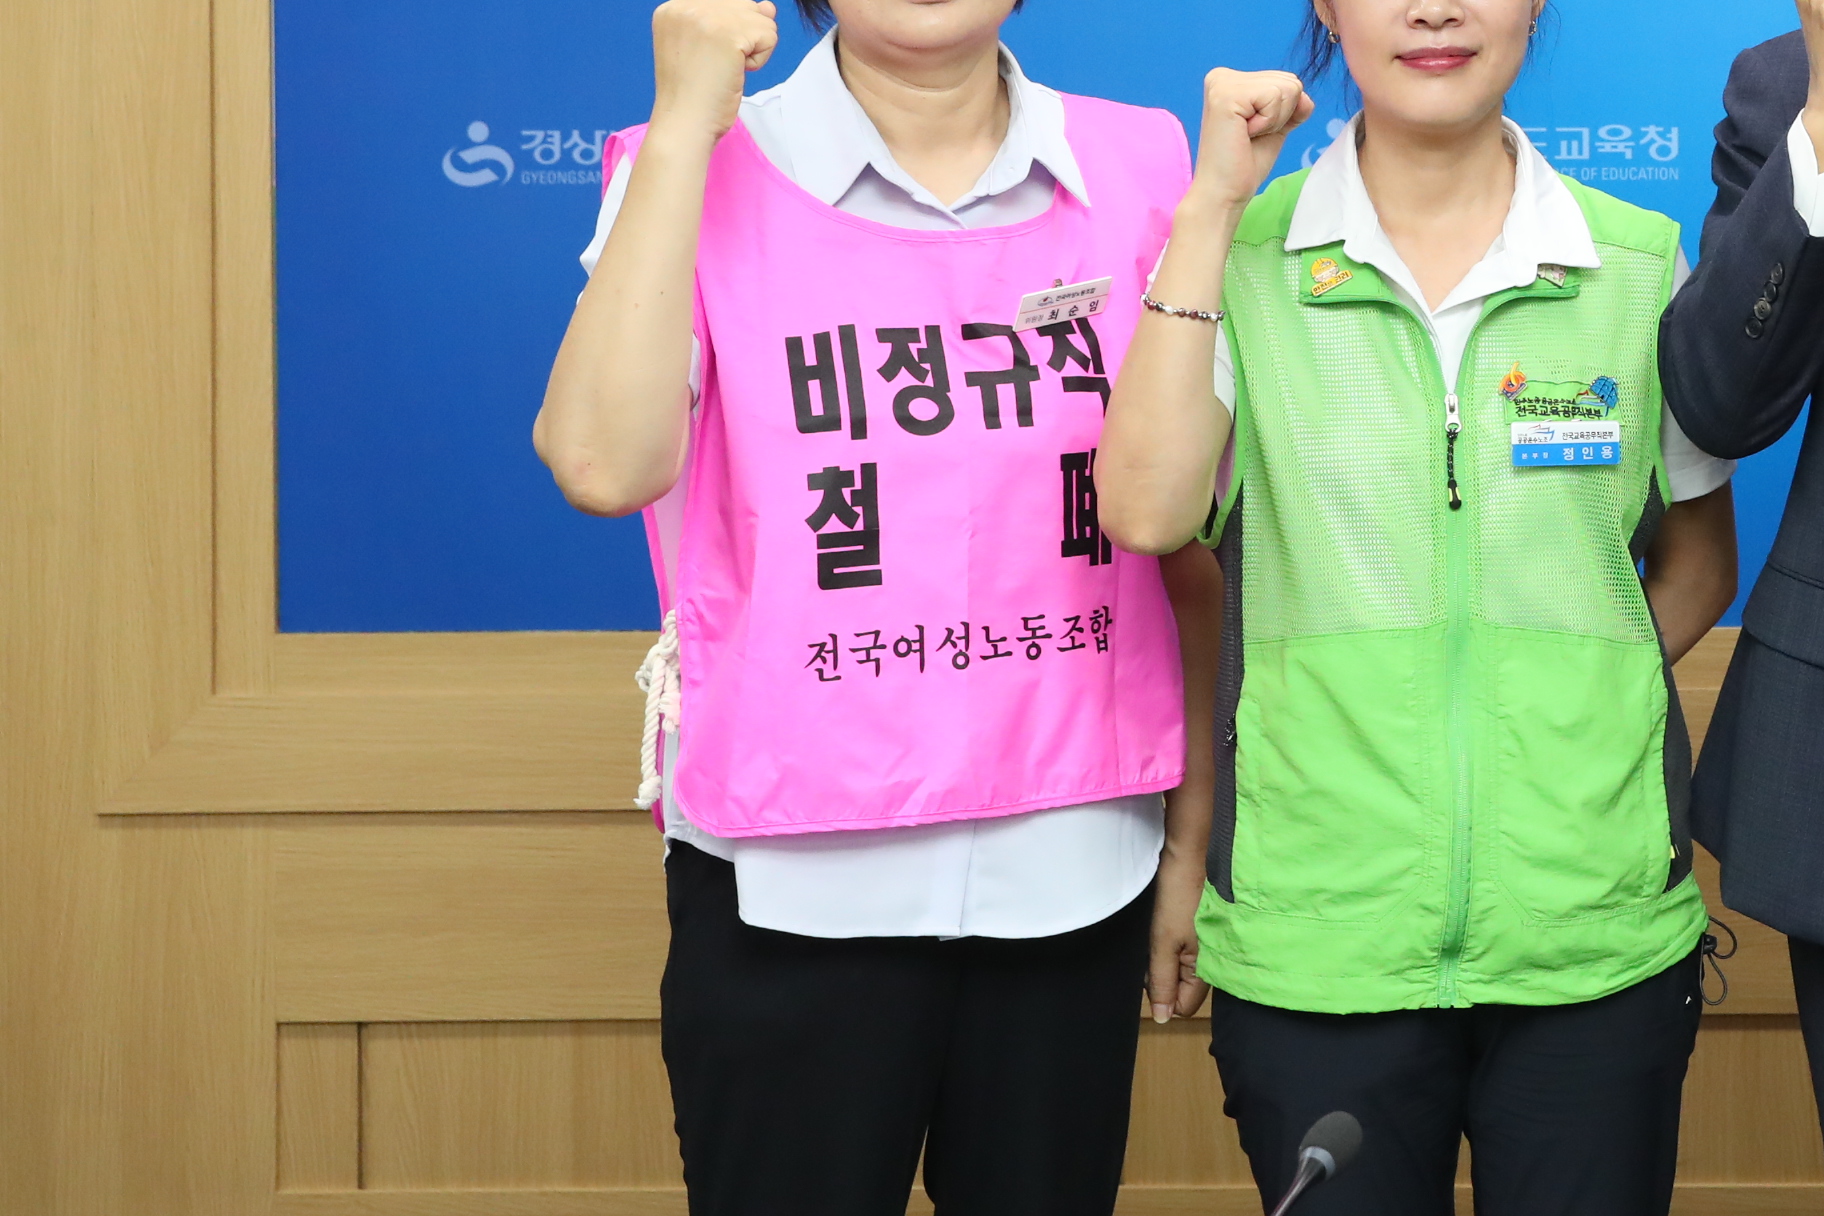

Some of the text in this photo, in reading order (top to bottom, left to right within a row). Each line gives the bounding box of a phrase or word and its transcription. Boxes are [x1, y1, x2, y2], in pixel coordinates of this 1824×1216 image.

[520, 129, 617, 165] 경상
[1580, 167, 1597, 180] OF
[1601, 167, 1679, 181] EDUCATION
[785, 317, 1111, 440] 비정규직
[804, 605, 1114, 683] 전국여성노동조합
